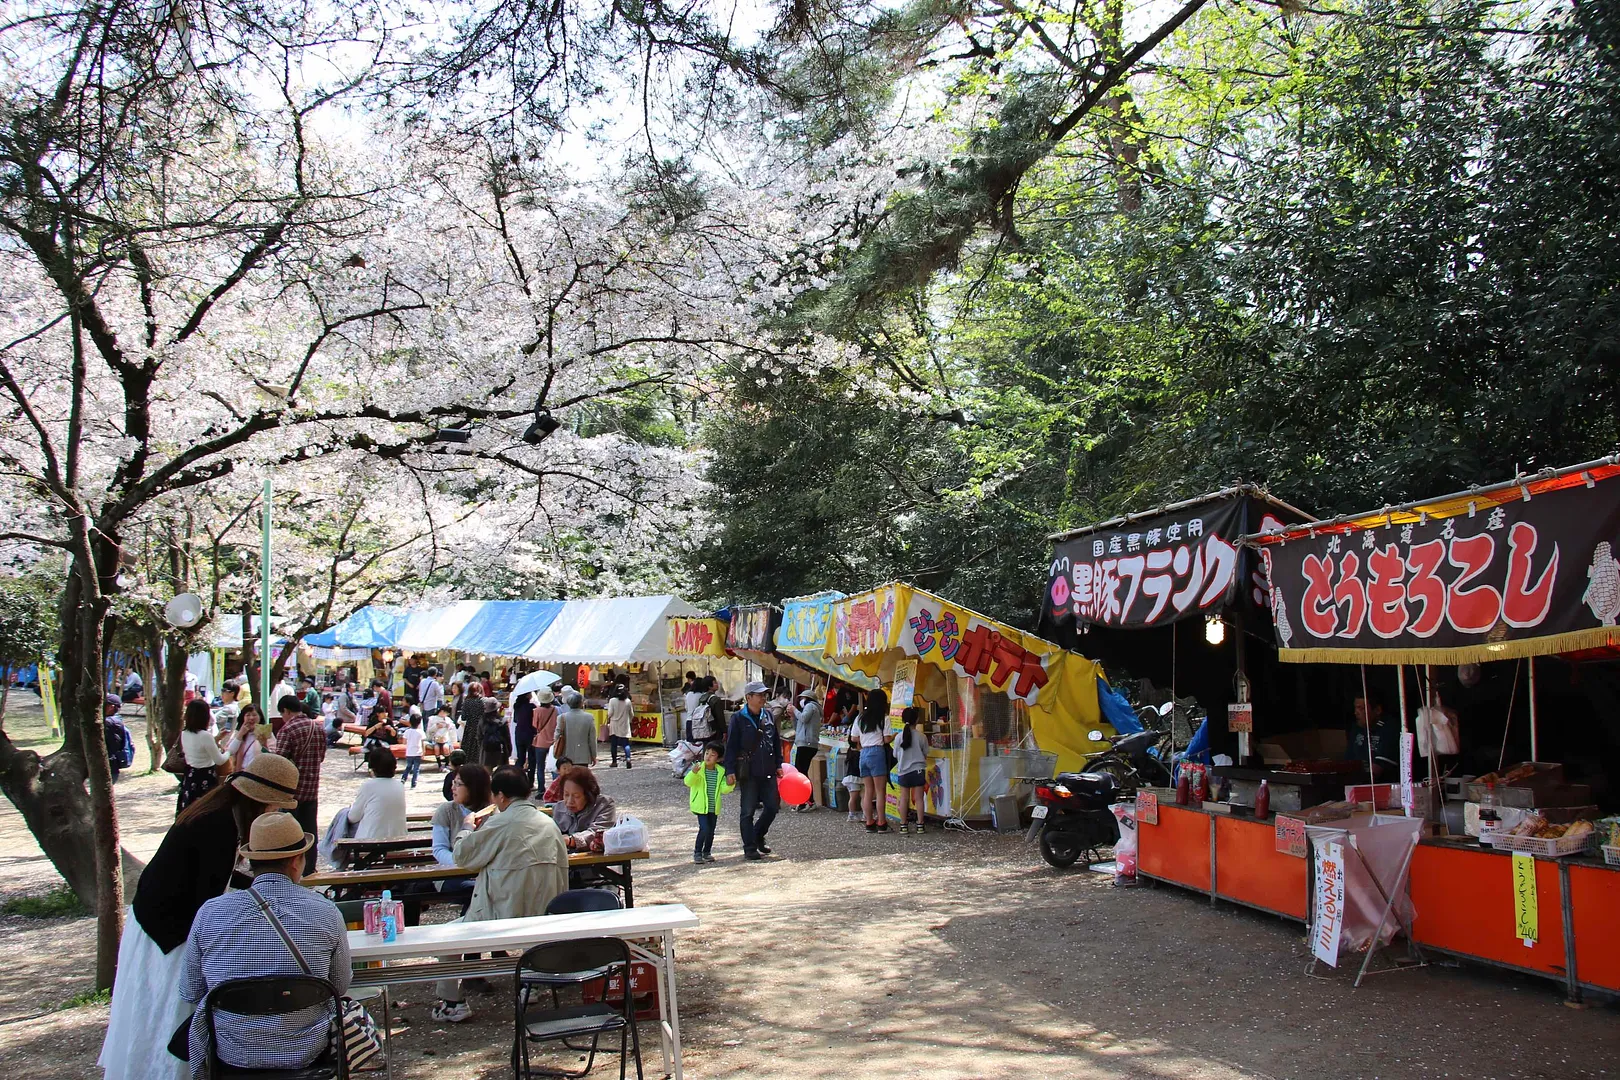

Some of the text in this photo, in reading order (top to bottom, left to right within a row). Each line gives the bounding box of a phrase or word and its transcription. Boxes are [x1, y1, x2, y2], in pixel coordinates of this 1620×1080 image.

[1093, 518, 1203, 558] 国産黒豚使用
[1326, 506, 1507, 554] 北海道名産
[1071, 532, 1237, 626] 黒豚フランク
[1300, 520, 1560, 640] とうもろこし
